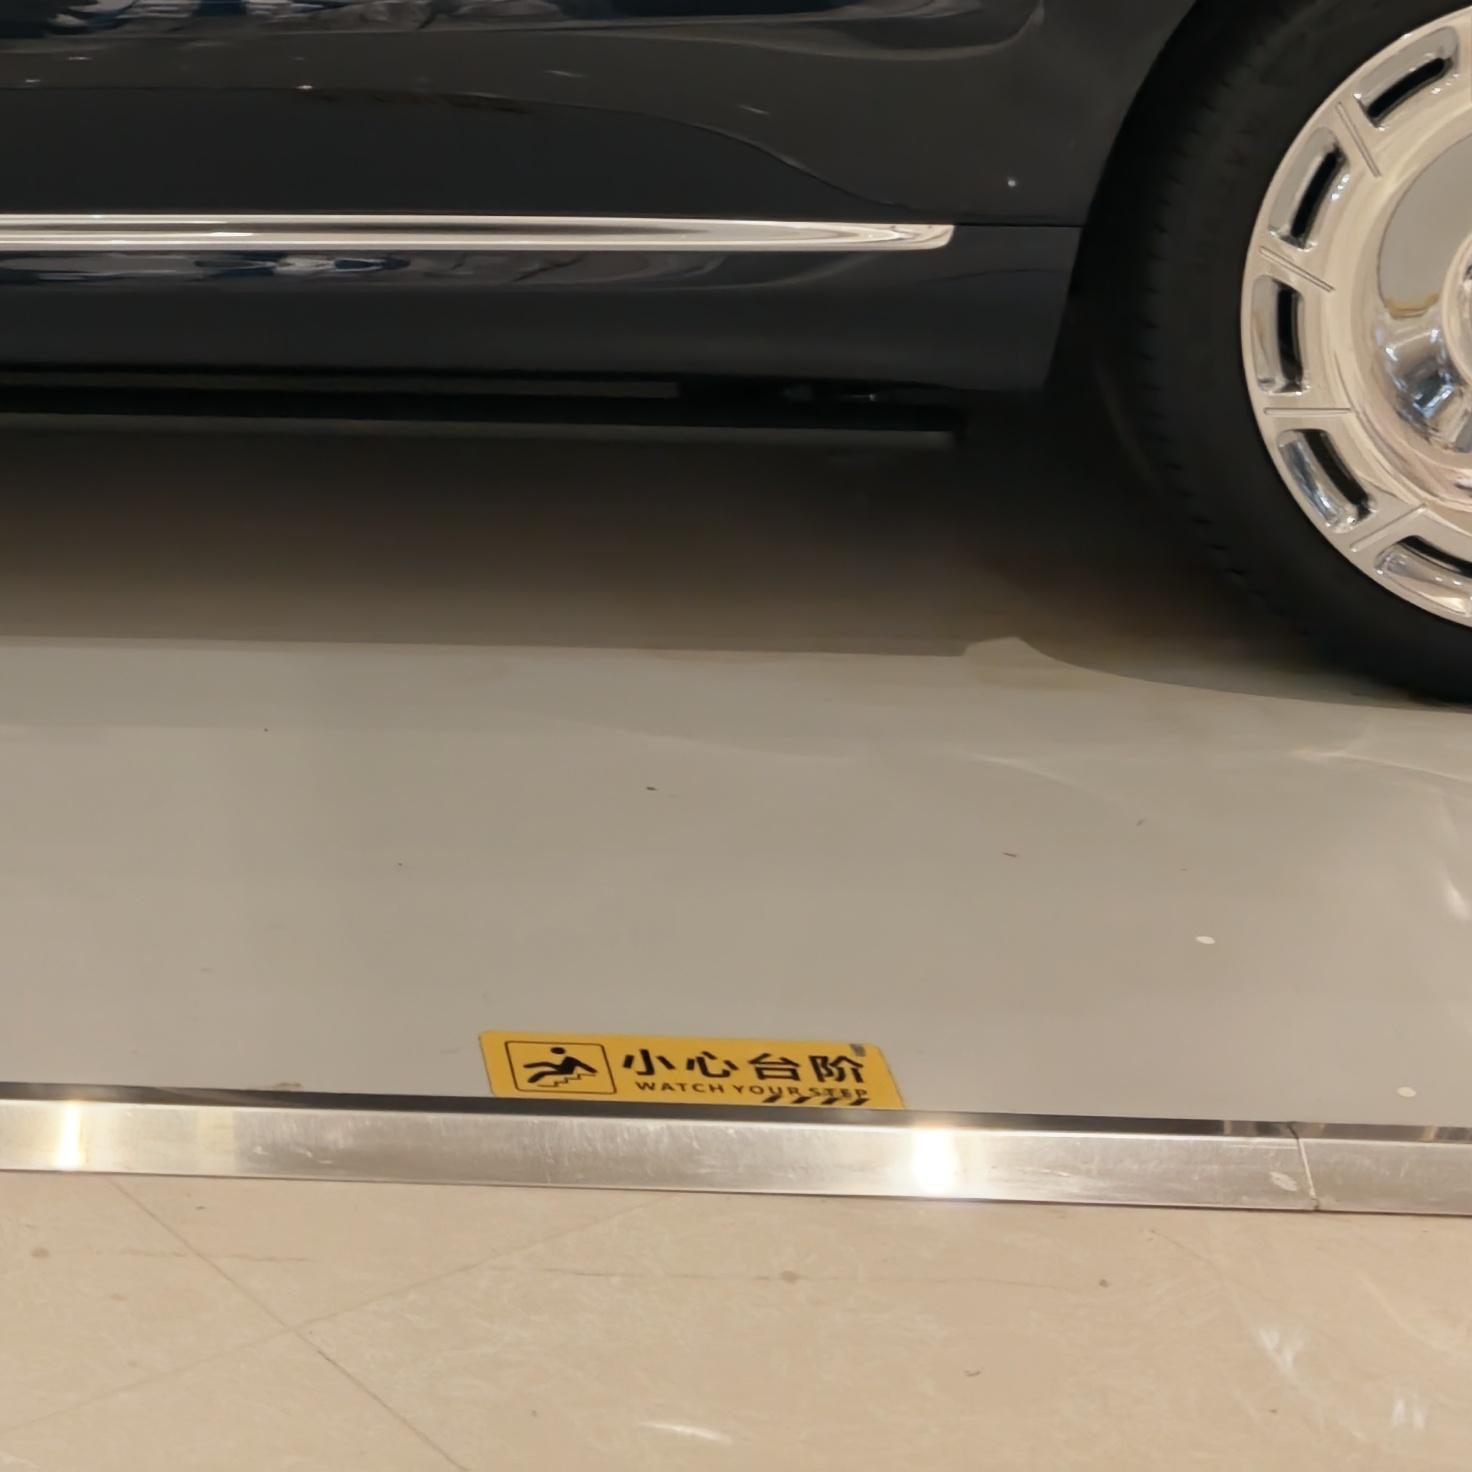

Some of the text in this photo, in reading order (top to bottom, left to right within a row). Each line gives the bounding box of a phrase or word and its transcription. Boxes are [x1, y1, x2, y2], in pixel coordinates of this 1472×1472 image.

[623, 1048, 865, 1084] 小心台阶
[635, 1080, 868, 1101] WATCH YOUR STEP
